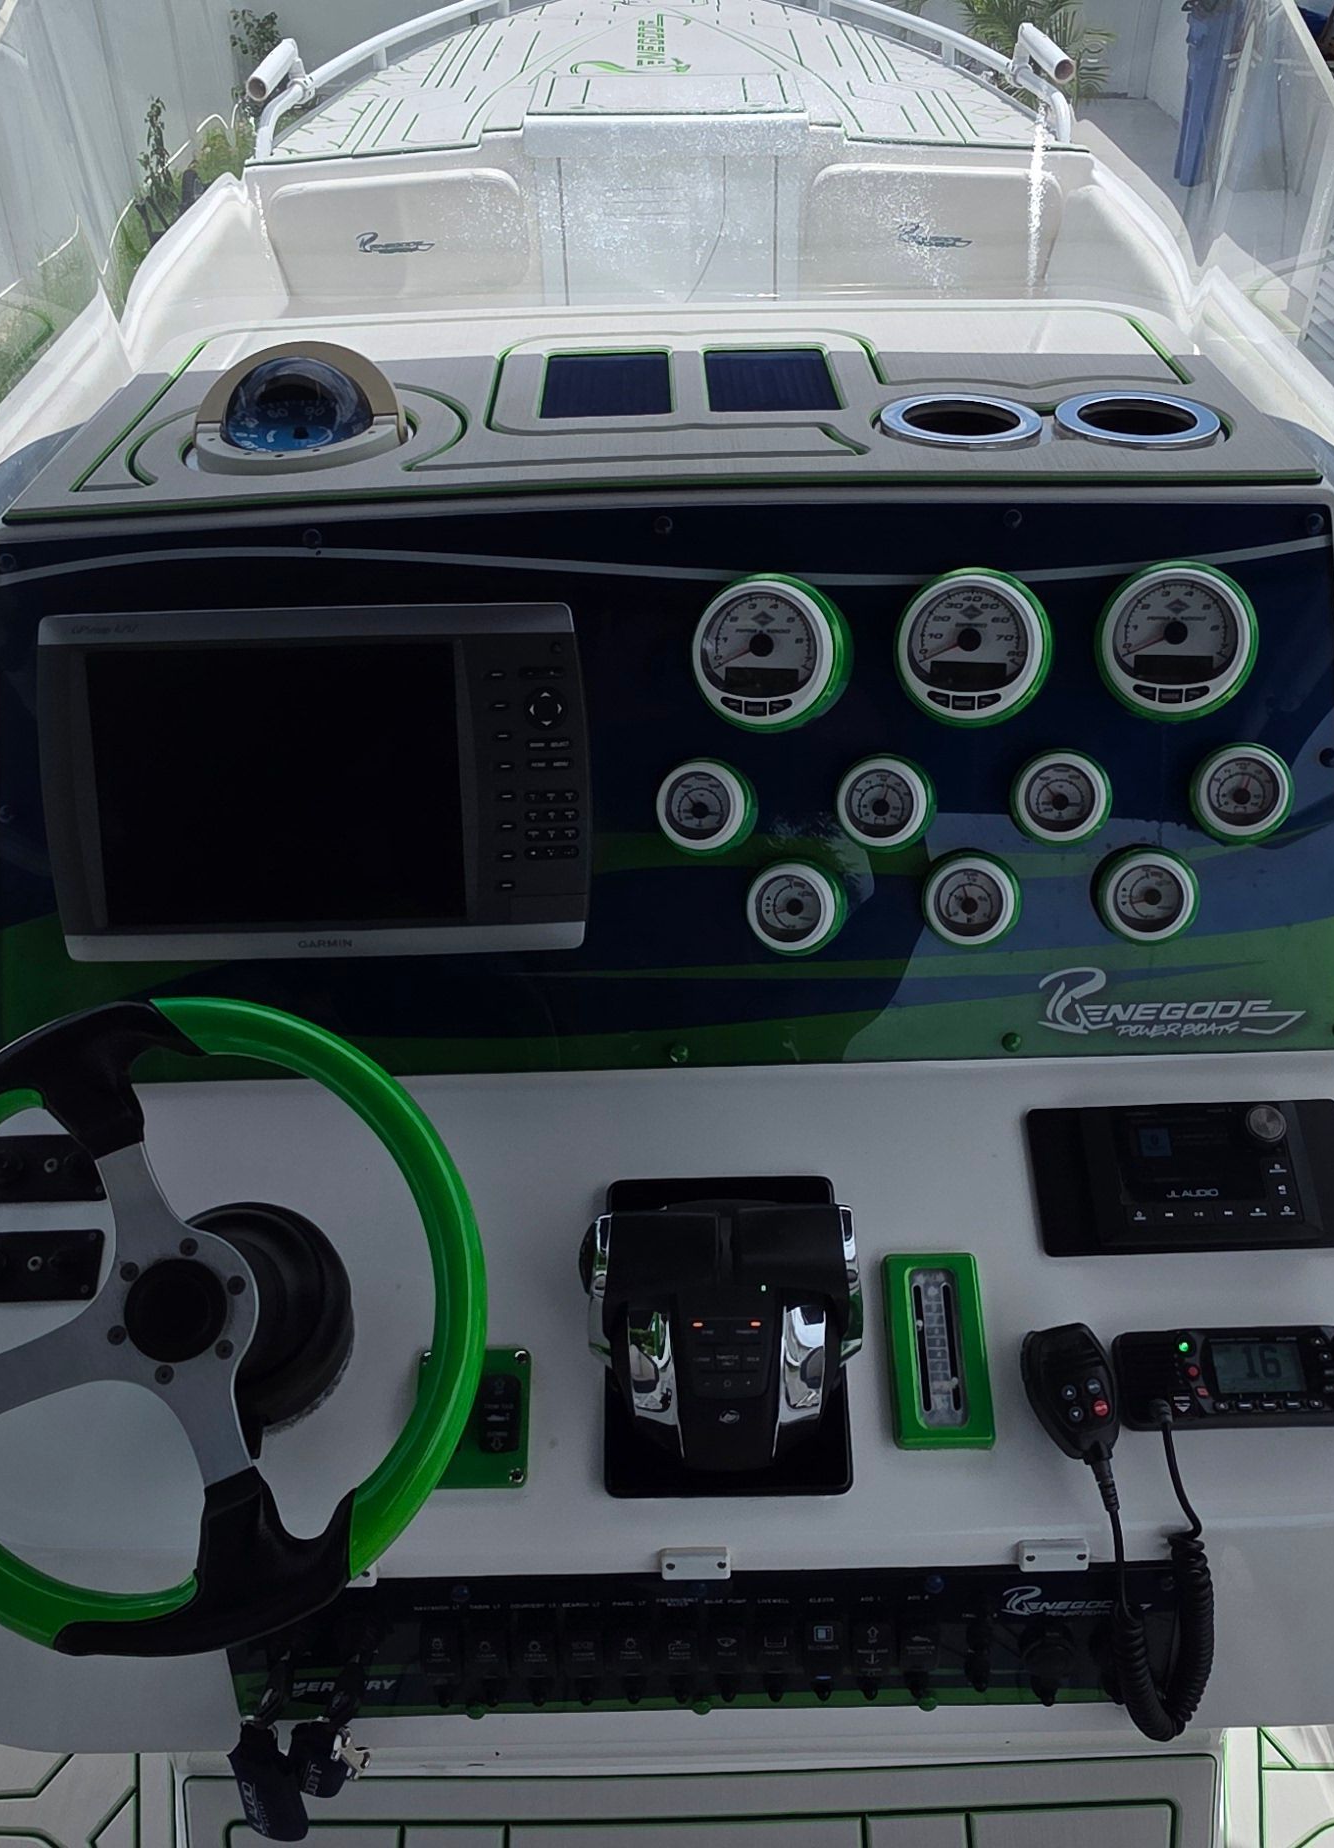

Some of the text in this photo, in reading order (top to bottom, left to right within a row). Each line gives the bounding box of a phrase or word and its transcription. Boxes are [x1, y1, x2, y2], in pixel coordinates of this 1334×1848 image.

[944, 602, 964, 610] 30
[995, 634, 1014, 642] 70
[297, 939, 353, 948] GARMIN
[1166, 1188, 1219, 1199] JL AUDIO
[1242, 1345, 1282, 1378] 16
